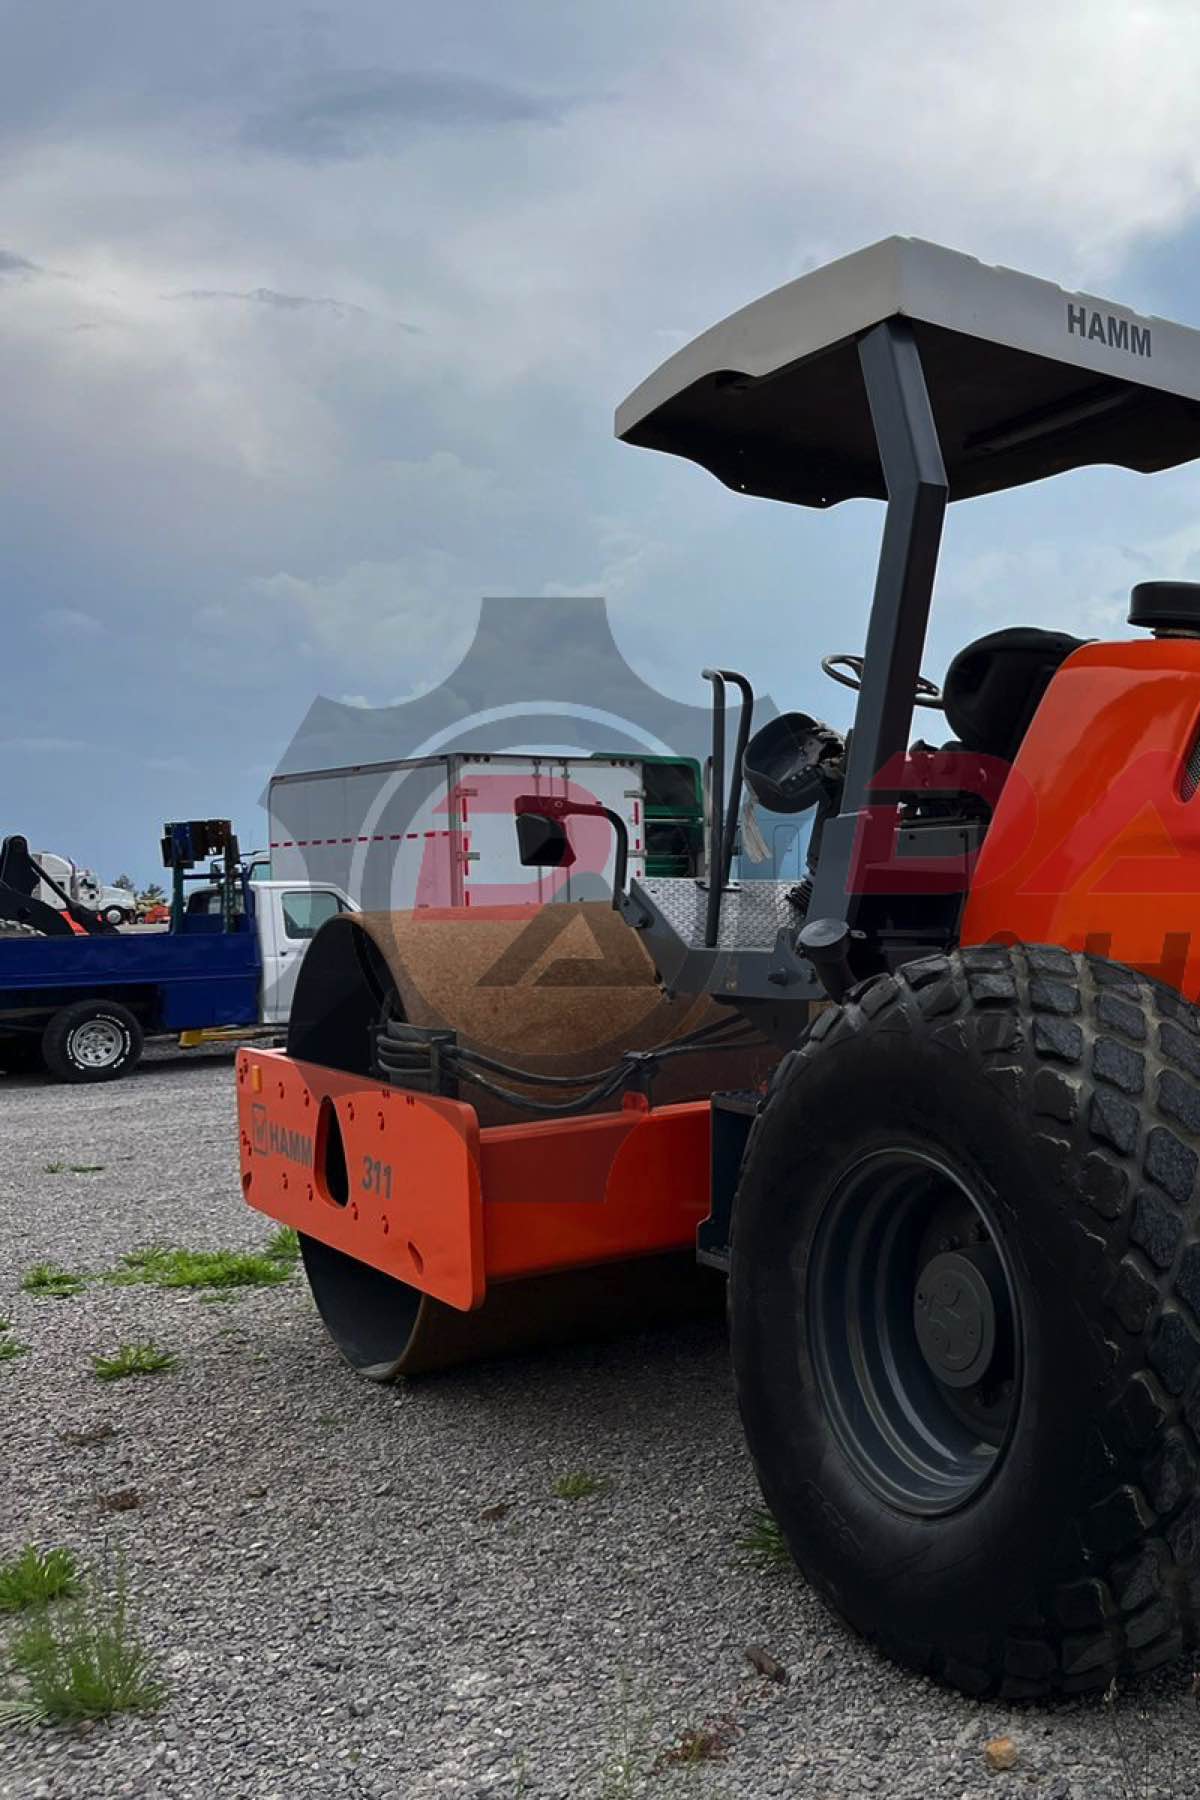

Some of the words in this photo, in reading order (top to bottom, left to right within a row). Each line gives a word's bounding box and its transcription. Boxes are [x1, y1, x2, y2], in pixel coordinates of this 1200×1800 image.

[1067, 303, 1152, 358] HAMM
[269, 1120, 313, 1169] HAMM
[362, 1154, 392, 1200] 311
